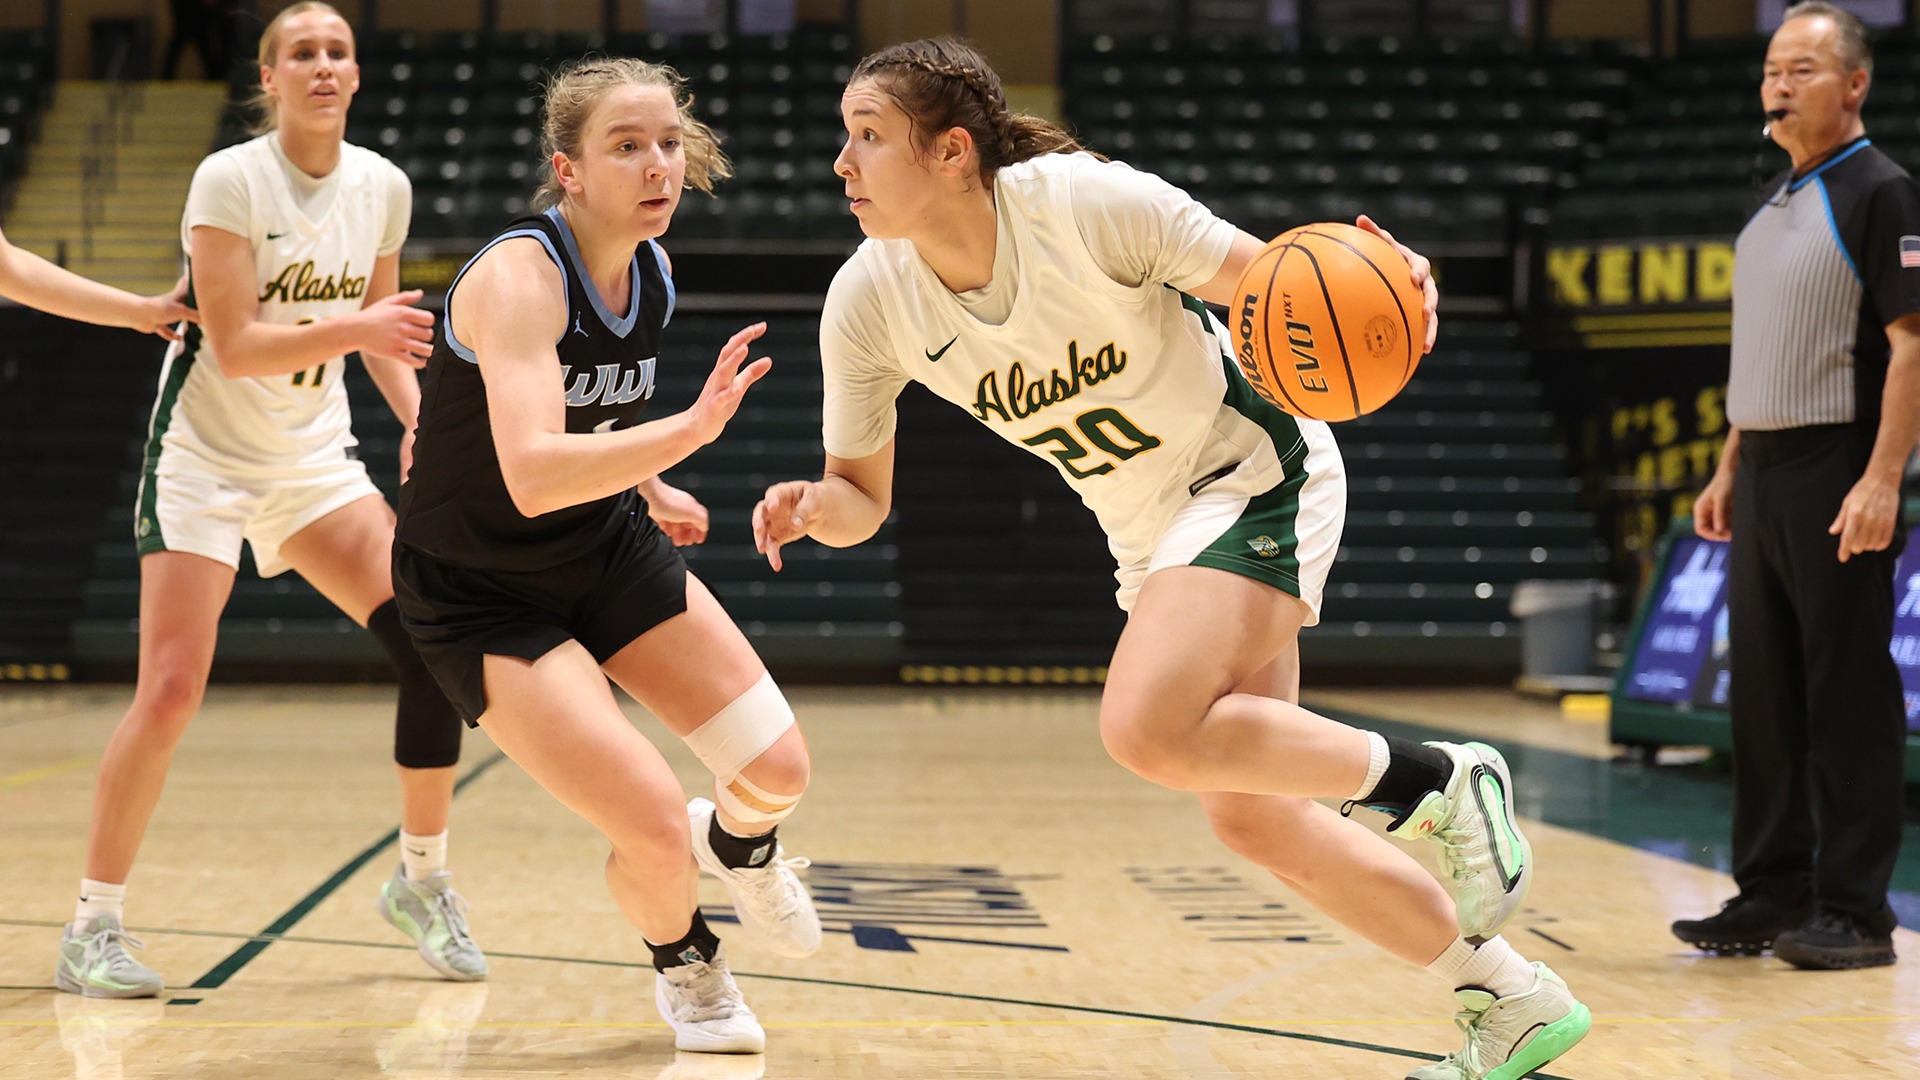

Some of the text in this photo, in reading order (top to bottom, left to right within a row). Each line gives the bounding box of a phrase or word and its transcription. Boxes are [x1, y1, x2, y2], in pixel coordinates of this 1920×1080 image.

[258, 259, 366, 303] Alaska
[1282, 291, 1294, 319] NXT
[972, 339, 1127, 423] Alaska
[1018, 406, 1164, 480] 20
